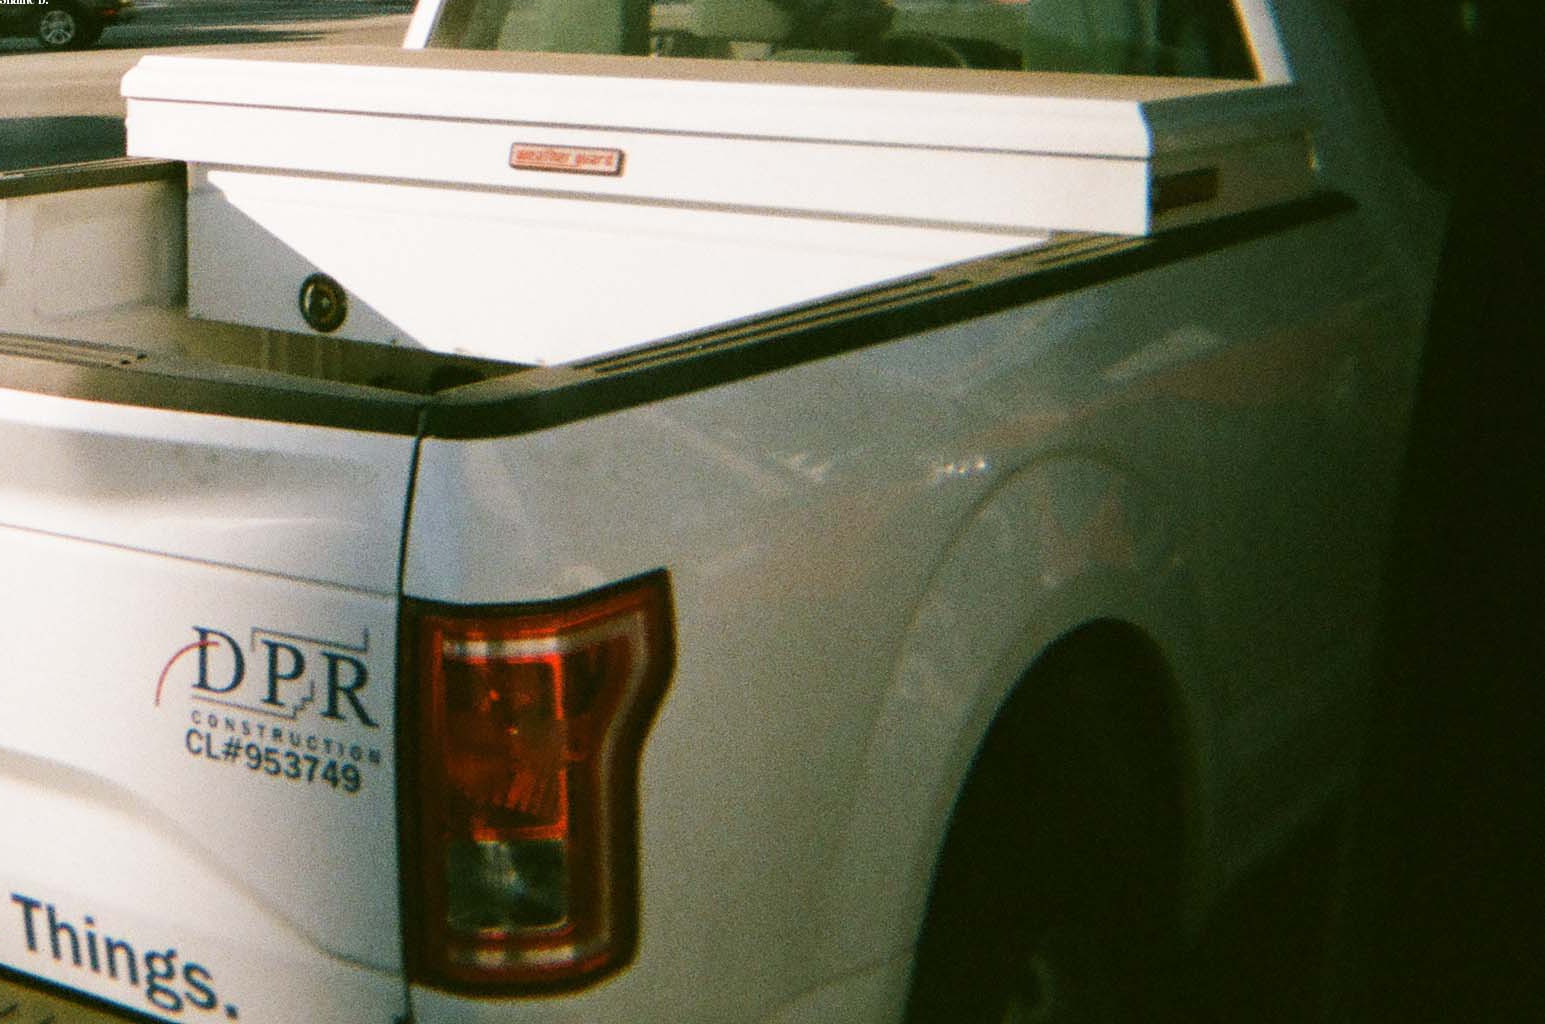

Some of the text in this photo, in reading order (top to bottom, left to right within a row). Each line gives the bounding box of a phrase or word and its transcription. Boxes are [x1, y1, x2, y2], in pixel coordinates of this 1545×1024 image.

[191, 625, 380, 728] DPR
[184, 727, 362, 794] CL#953749
[190, 709, 381, 765] CONSTRUCTION
[10, 891, 239, 1021] Things.
